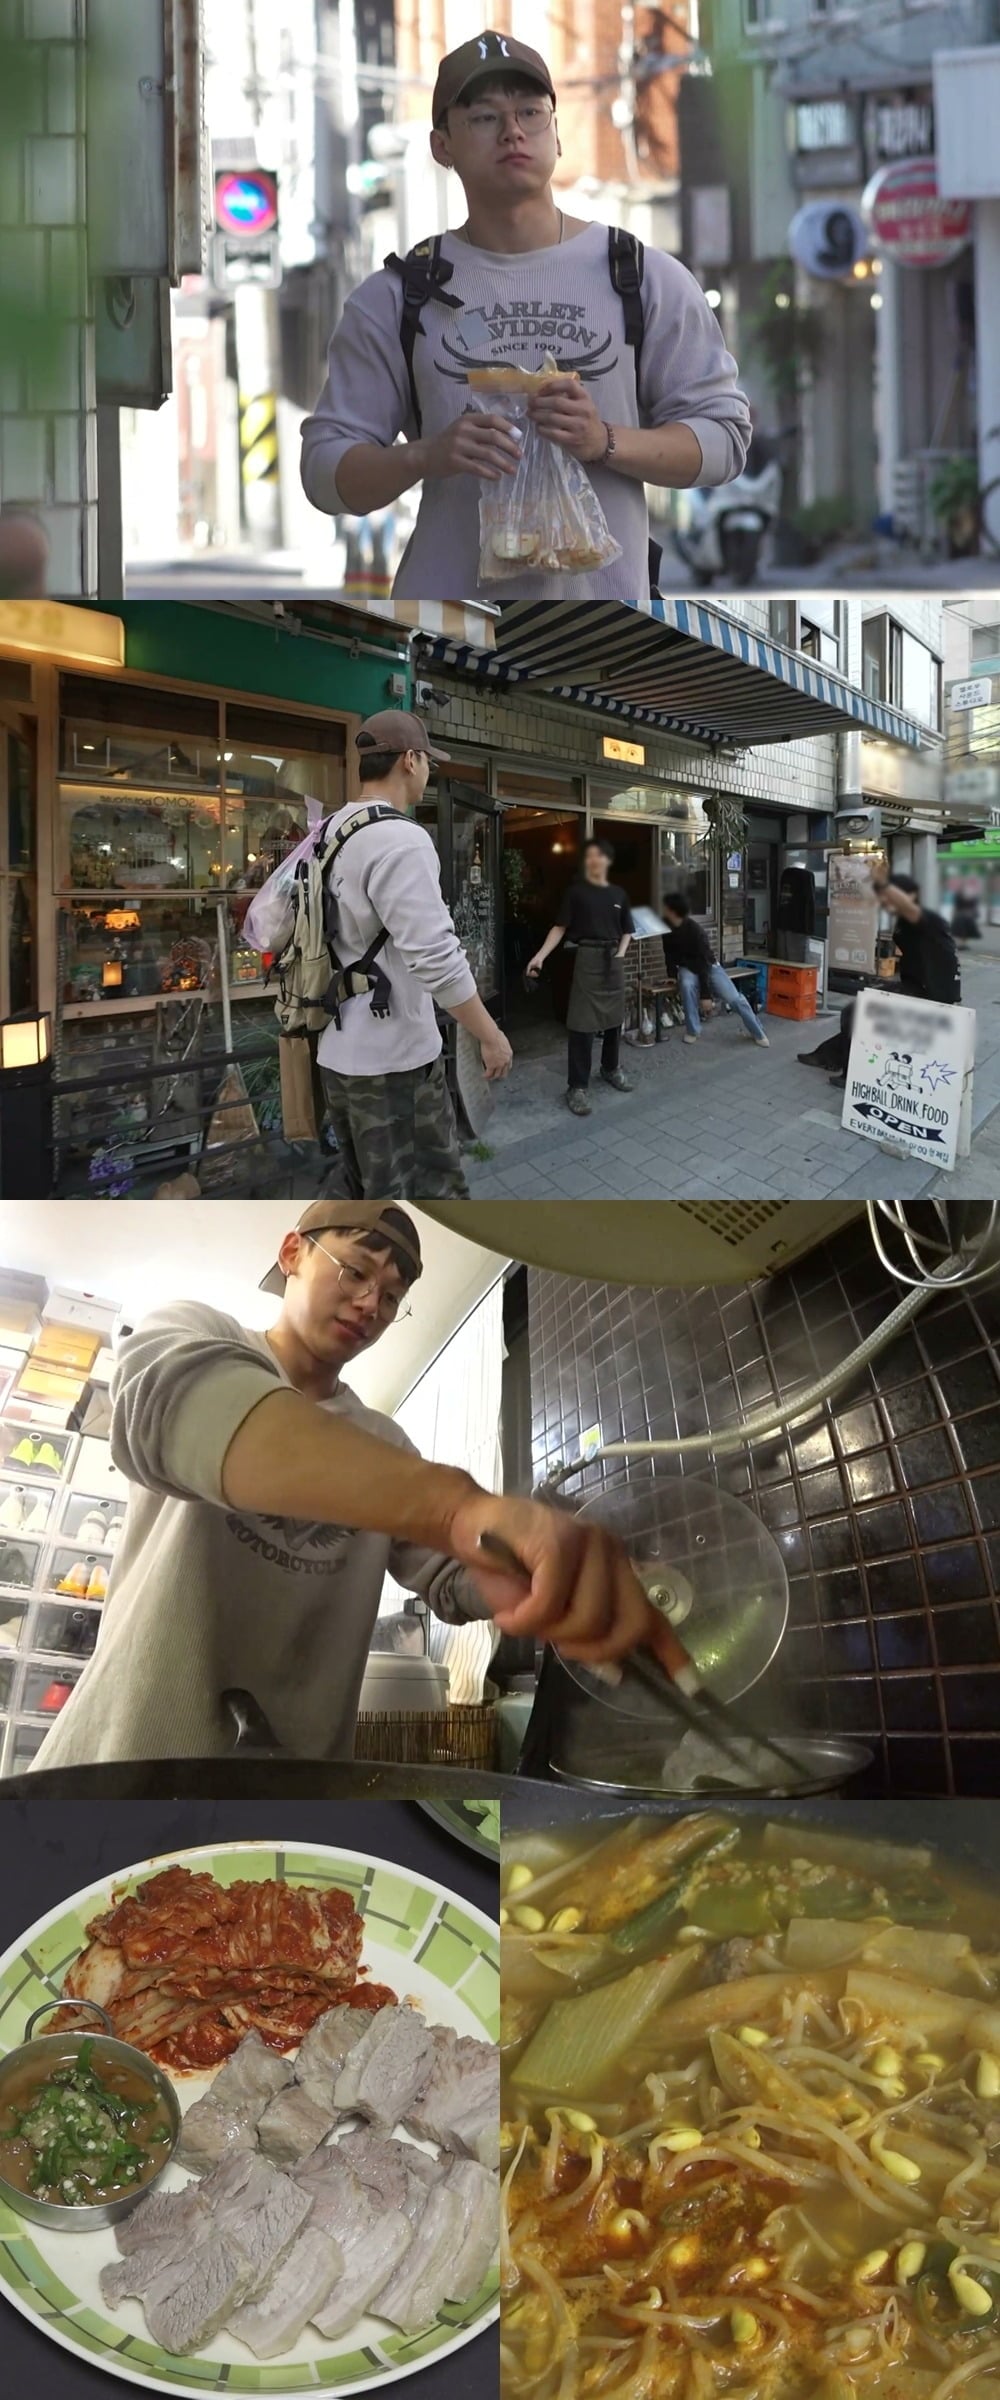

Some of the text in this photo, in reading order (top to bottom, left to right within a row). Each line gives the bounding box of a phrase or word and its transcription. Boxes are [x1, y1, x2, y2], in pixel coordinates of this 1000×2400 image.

[456, 318, 598, 351] VIDSON
[490, 342, 563, 357] SINCE 1903
[869, 1106, 928, 1139] OPEN
[922, 1103, 949, 1126] FOOD
